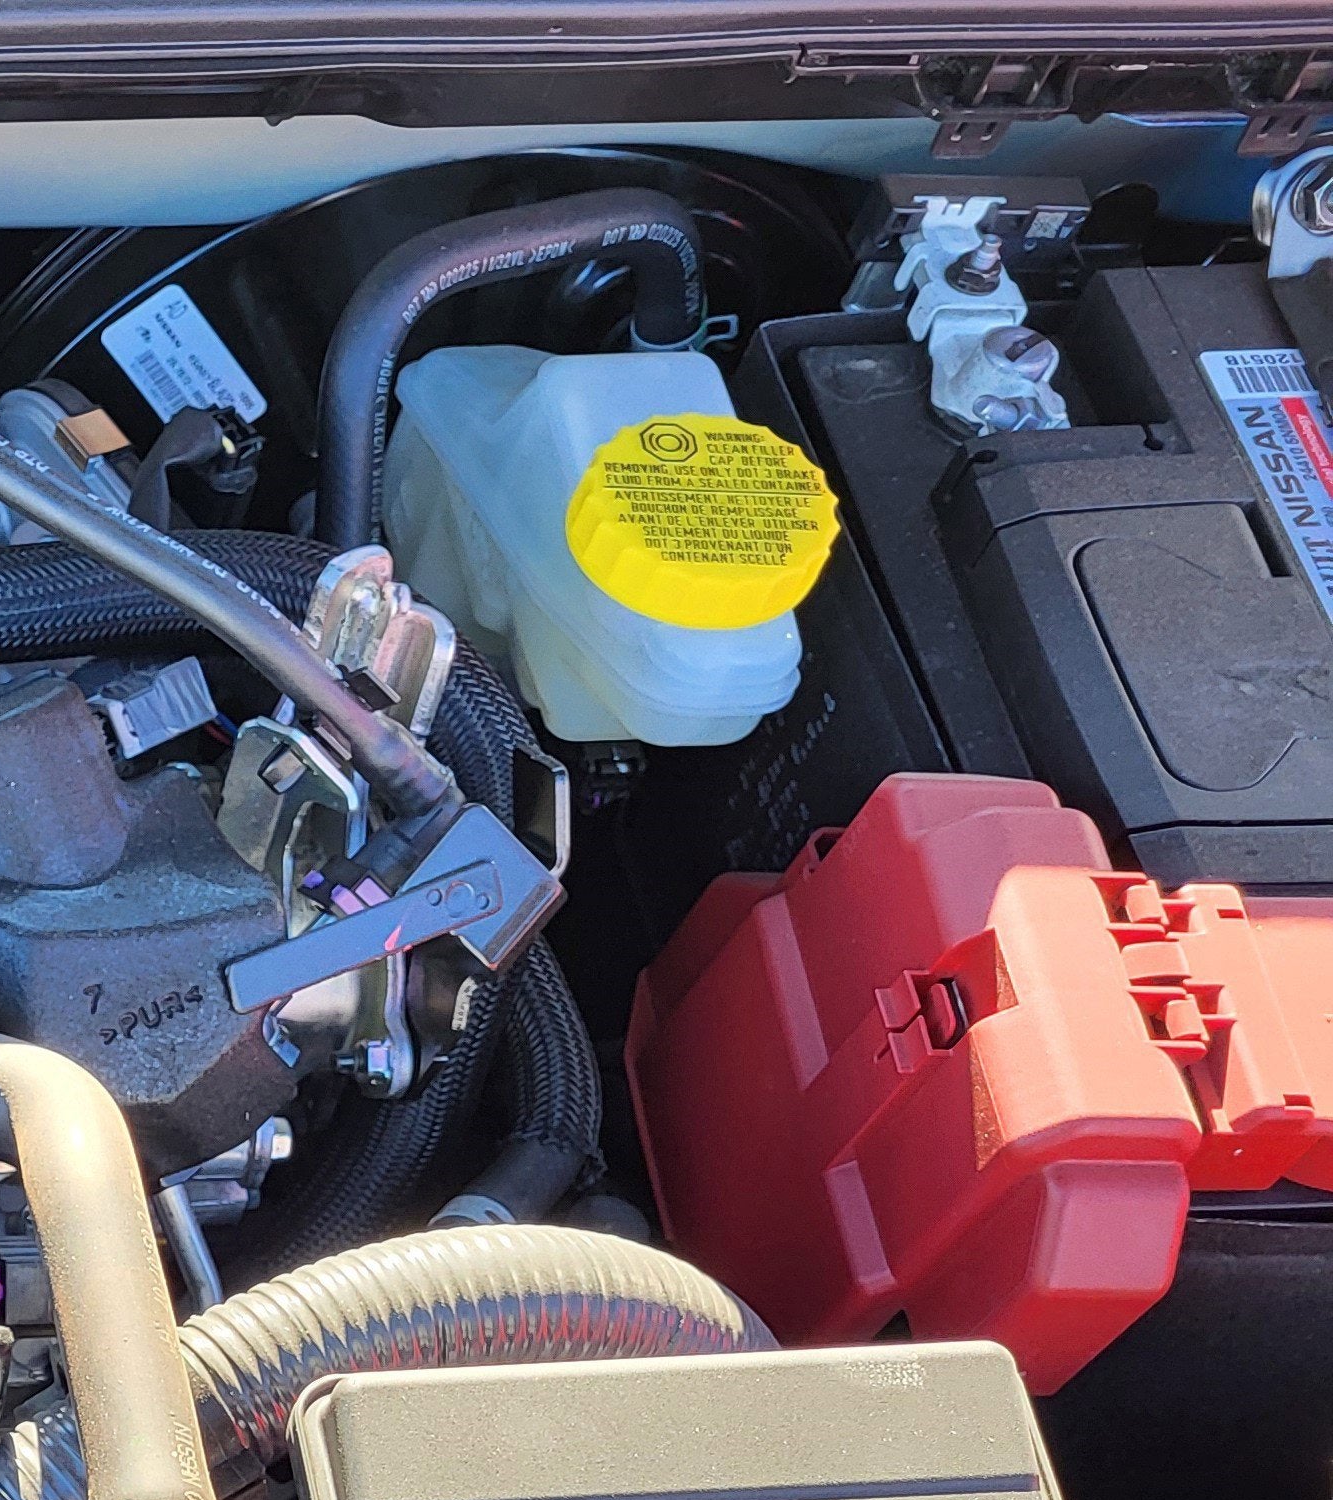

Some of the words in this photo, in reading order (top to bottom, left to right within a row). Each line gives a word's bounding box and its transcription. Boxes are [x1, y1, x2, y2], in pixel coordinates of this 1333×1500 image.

[706, 443, 748, 455] CLEAN
[751, 445, 795, 456] FILLER
[709, 455, 734, 466] CAP
[741, 456, 788, 468] BEFORE
[1237, 405, 1323, 527] NISSAN
[675, 466, 699, 477] USE
[700, 466, 732, 478] ONLY
[736, 467, 760, 478] DOT
[764, 468, 773, 479] 3
[775, 468, 818, 481] BRAKE
[605, 474, 642, 485] FLUID
[646, 475, 682, 487] FROM
[686, 477, 696, 487] A
[698, 478, 749, 489] SEALED
[726, 494, 793, 507] NETTOYER
[795, 497, 811, 508] LE
[631, 501, 687, 514] BOUCHON
[691, 504, 706, 515] DE
[711, 505, 798, 518] REMPLISSAGE
[618, 513, 663, 525] AVANT
[667, 514, 682, 525] DE
[763, 518, 819, 531] UTILISER
[643, 526, 717, 539] SEULEMENT
[722, 528, 738, 539] DU
[743, 529, 789, 542] LIQUIDE
[644, 538, 668, 549] DOT
[673, 539, 682, 550] 3
[685, 539, 760, 553] PROVENANT
[660, 550, 735, 564] CONTENANT
